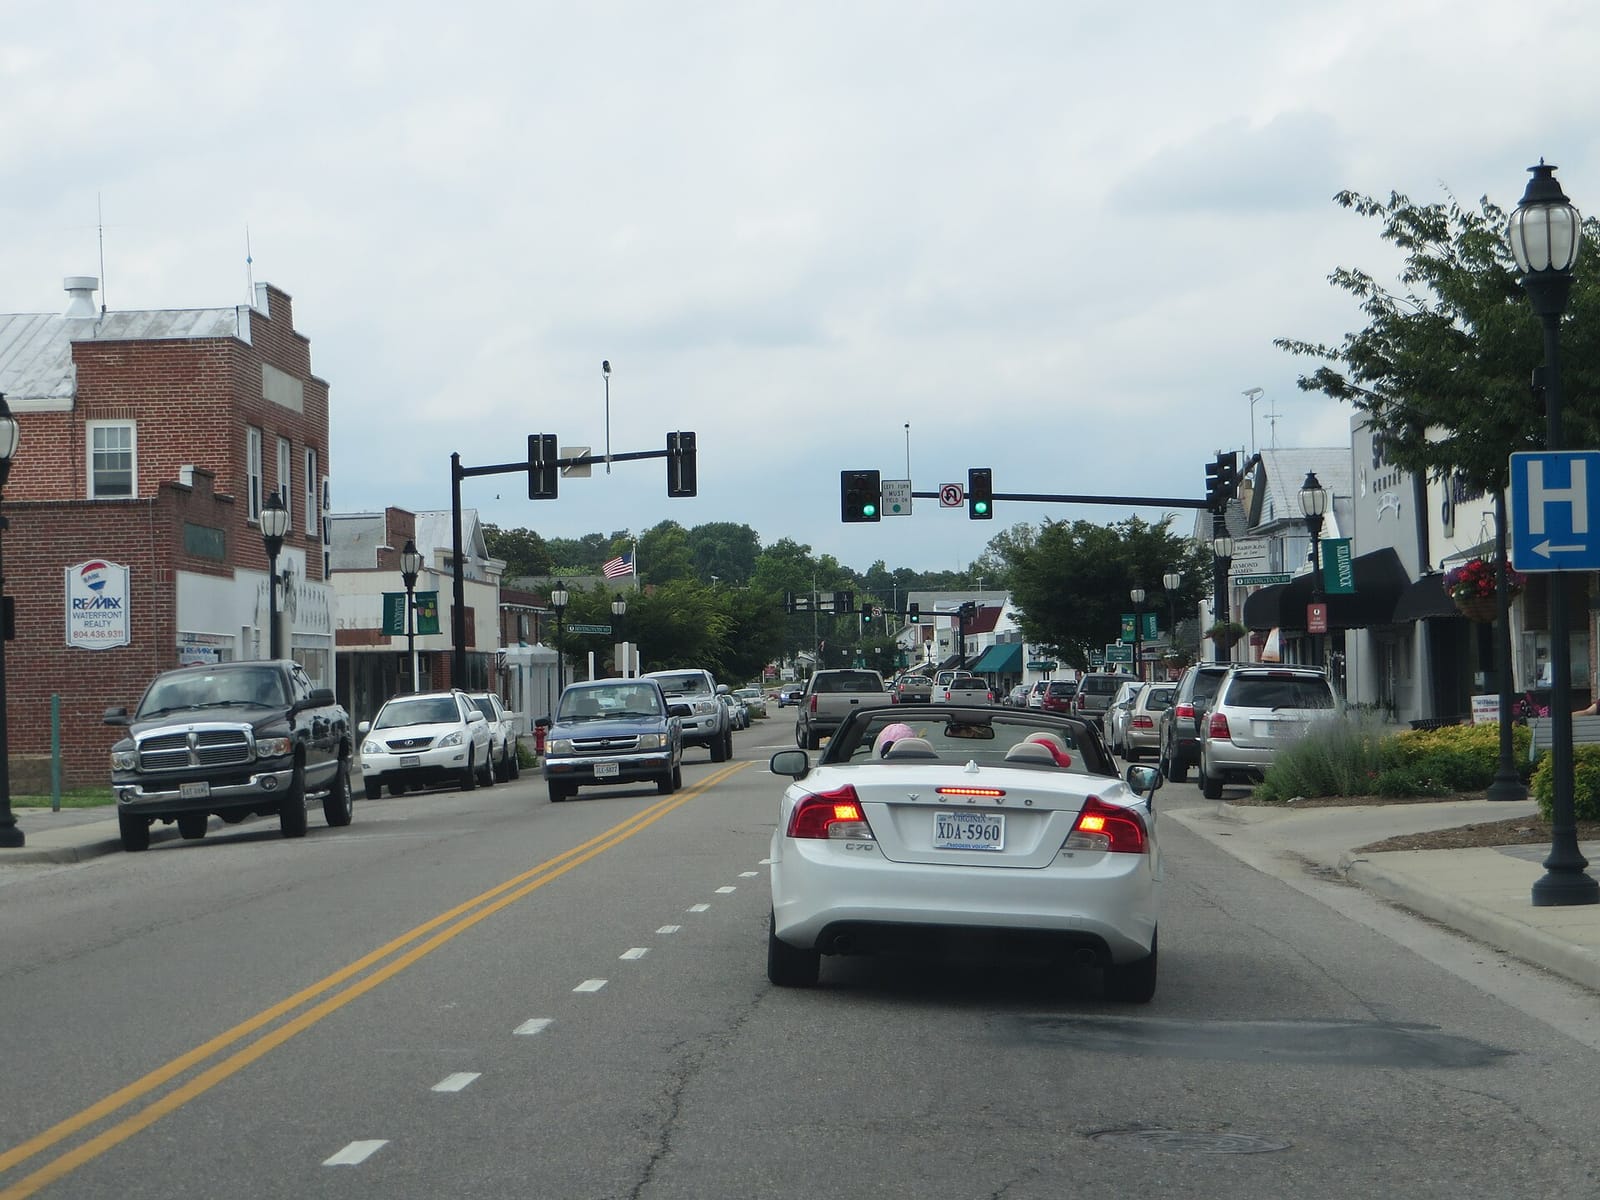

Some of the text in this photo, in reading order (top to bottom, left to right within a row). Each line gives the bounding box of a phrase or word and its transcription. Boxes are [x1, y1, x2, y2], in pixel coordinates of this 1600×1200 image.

[1527, 459, 1588, 534] H
[72, 596, 122, 610] RE/MAX
[72, 611, 122, 620] WATERFRONT
[84, 620, 111, 628] REALTY
[73, 630, 124, 639] 804.436.9311
[908, 792, 1033, 807] VOLVO
[937, 822, 1000, 841] XDA-5960
[845, 843, 874, 851] C70
